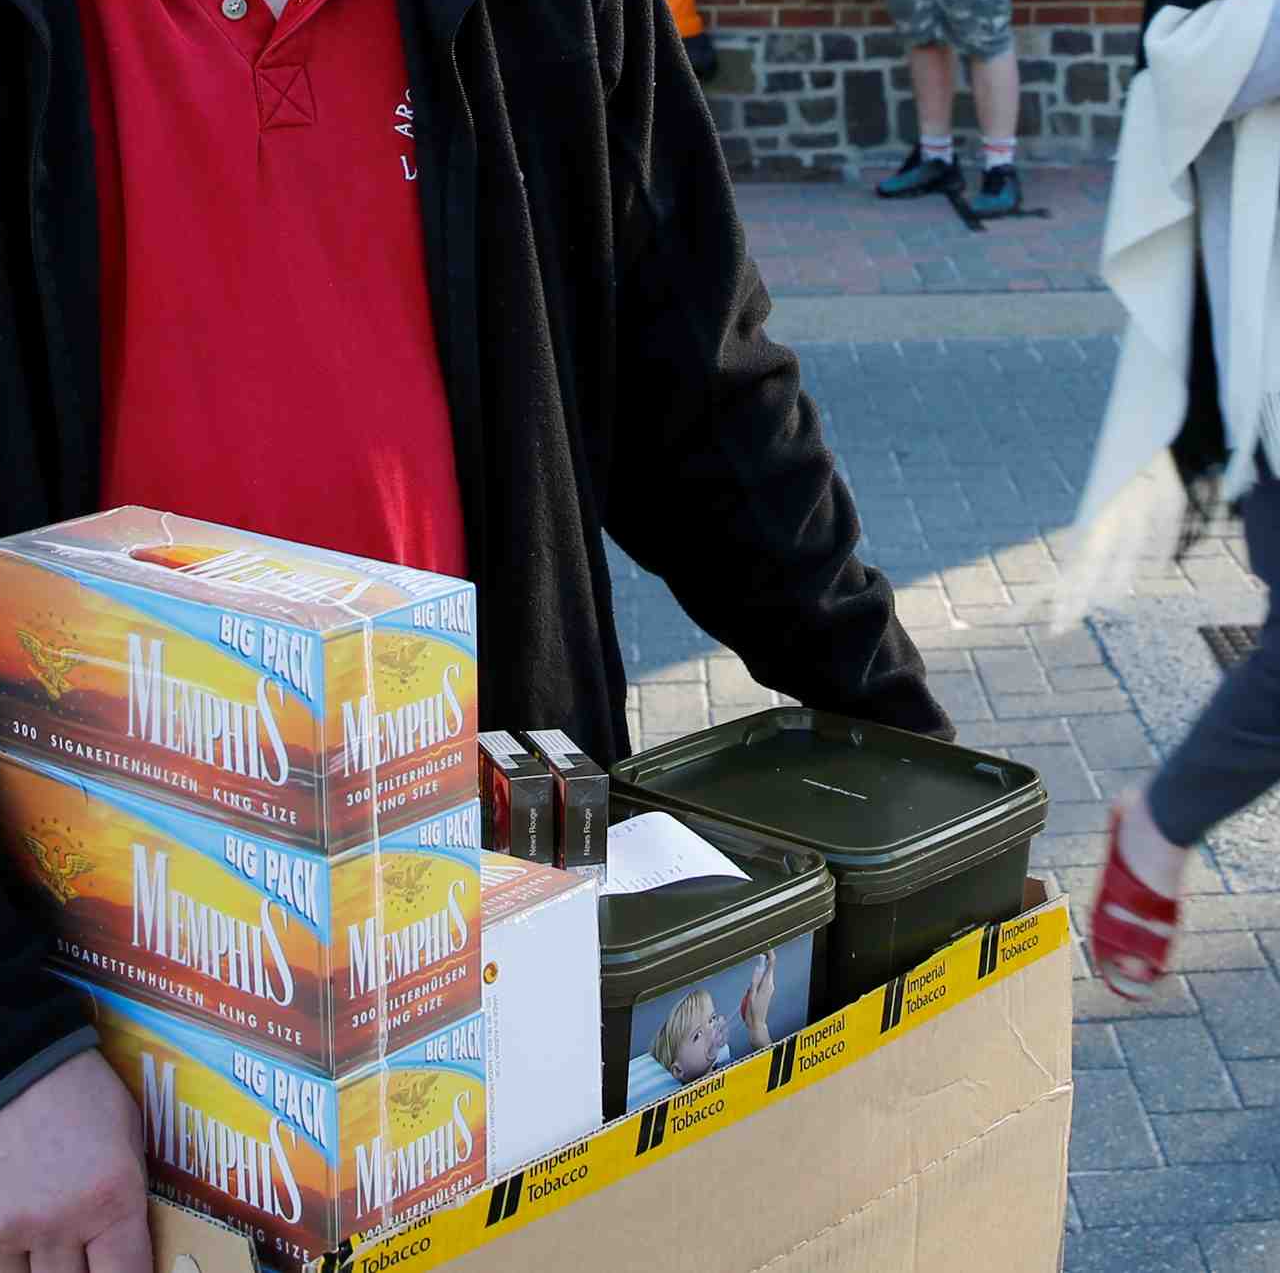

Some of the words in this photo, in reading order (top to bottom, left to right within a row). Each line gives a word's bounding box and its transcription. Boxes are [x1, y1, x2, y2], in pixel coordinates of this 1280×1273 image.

[412, 605, 435, 630] BIG
[440, 591, 472, 635] PACK
[220, 613, 256, 657] BIG
[261, 624, 314, 703] PACK
[126, 633, 289, 787] MEMPHIS
[341, 662, 464, 778] MEMPHIS
[12, 720, 38, 741] 300
[50, 734, 199, 794] SIGARETTENHULZEN
[212, 785, 253, 810] KING
[262, 801, 298, 826] SIZE
[346, 787, 370, 807] 300
[377, 750, 463, 793] FILTERHÜLSEN
[412, 780, 440, 802] SIZE
[418, 821, 441, 847] BIG
[446, 806, 478, 850] PACK
[224, 835, 258, 878] BIG
[264, 849, 320, 926] PACK
[131, 842, 295, 1006] MEMPHIS
[348, 880, 468, 1000] MEMPHIS
[1001, 933, 1039, 964] Tobacco
[906, 983, 946, 1015] Tobacco
[907, 962, 946, 994] Imperial
[218, 1002, 258, 1028] KING
[267, 1021, 302, 1046] SIZE
[351, 1008, 376, 1028] 300
[384, 1010, 411, 1032] ING
[417, 995, 443, 1018] SIZE
[799, 1014, 846, 1052] Imperial
[425, 1039, 448, 1063] BIG
[451, 1022, 481, 1061] PACK
[798, 1040, 846, 1073] Tobacco
[233, 1050, 267, 1097] BIG
[272, 1068, 326, 1150] PACK
[673, 1073, 726, 1111] Imperial
[142, 1051, 302, 1224] MEMPHIS
[671, 1099, 725, 1135] Tobacco
[355, 1090, 472, 1220] MEMPHIS
[527, 1165, 588, 1204] Tobacco
[275, 1237, 310, 1263] SIZE
[361, 1237, 431, 1273] Tobacco
